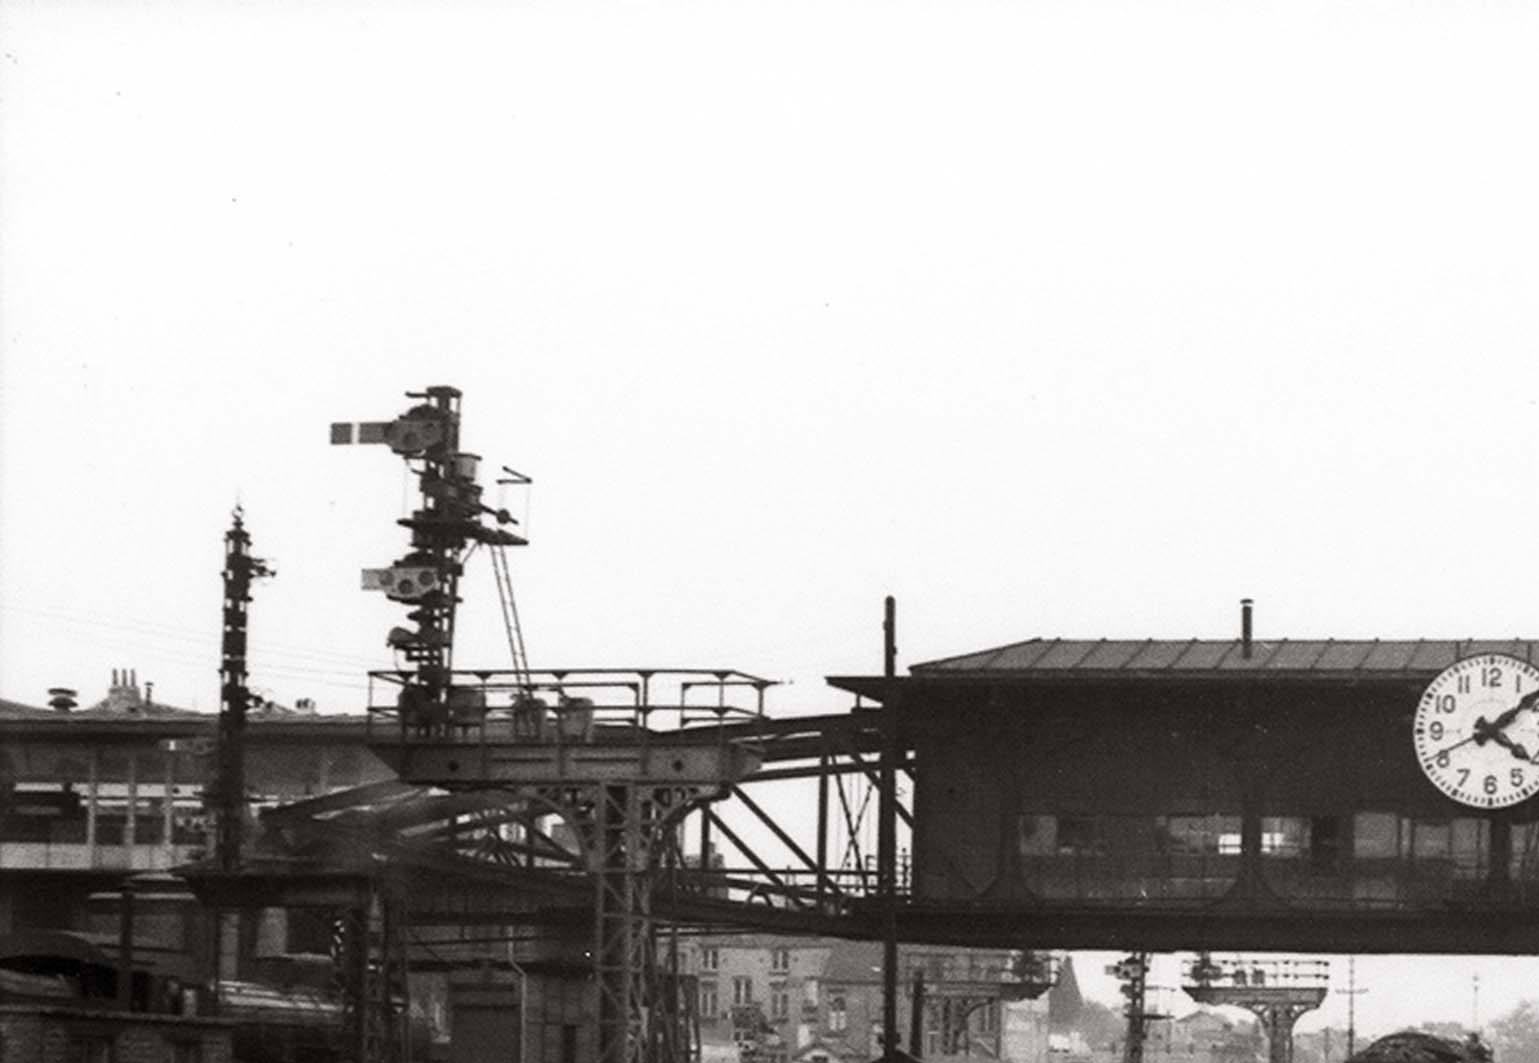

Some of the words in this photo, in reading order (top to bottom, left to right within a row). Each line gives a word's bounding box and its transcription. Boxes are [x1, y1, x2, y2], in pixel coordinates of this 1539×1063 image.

[1458, 674, 1470, 694] 11
[1482, 668, 1502, 687] 12
[1516, 674, 1521, 693] 1
[1435, 694, 1456, 714] 10
[1429, 721, 1443, 741] 9
[1436, 749, 1450, 768] 8
[1456, 768, 1471, 787] 7
[1483, 775, 1498, 795] 6
[1510, 768, 1524, 787] 5
